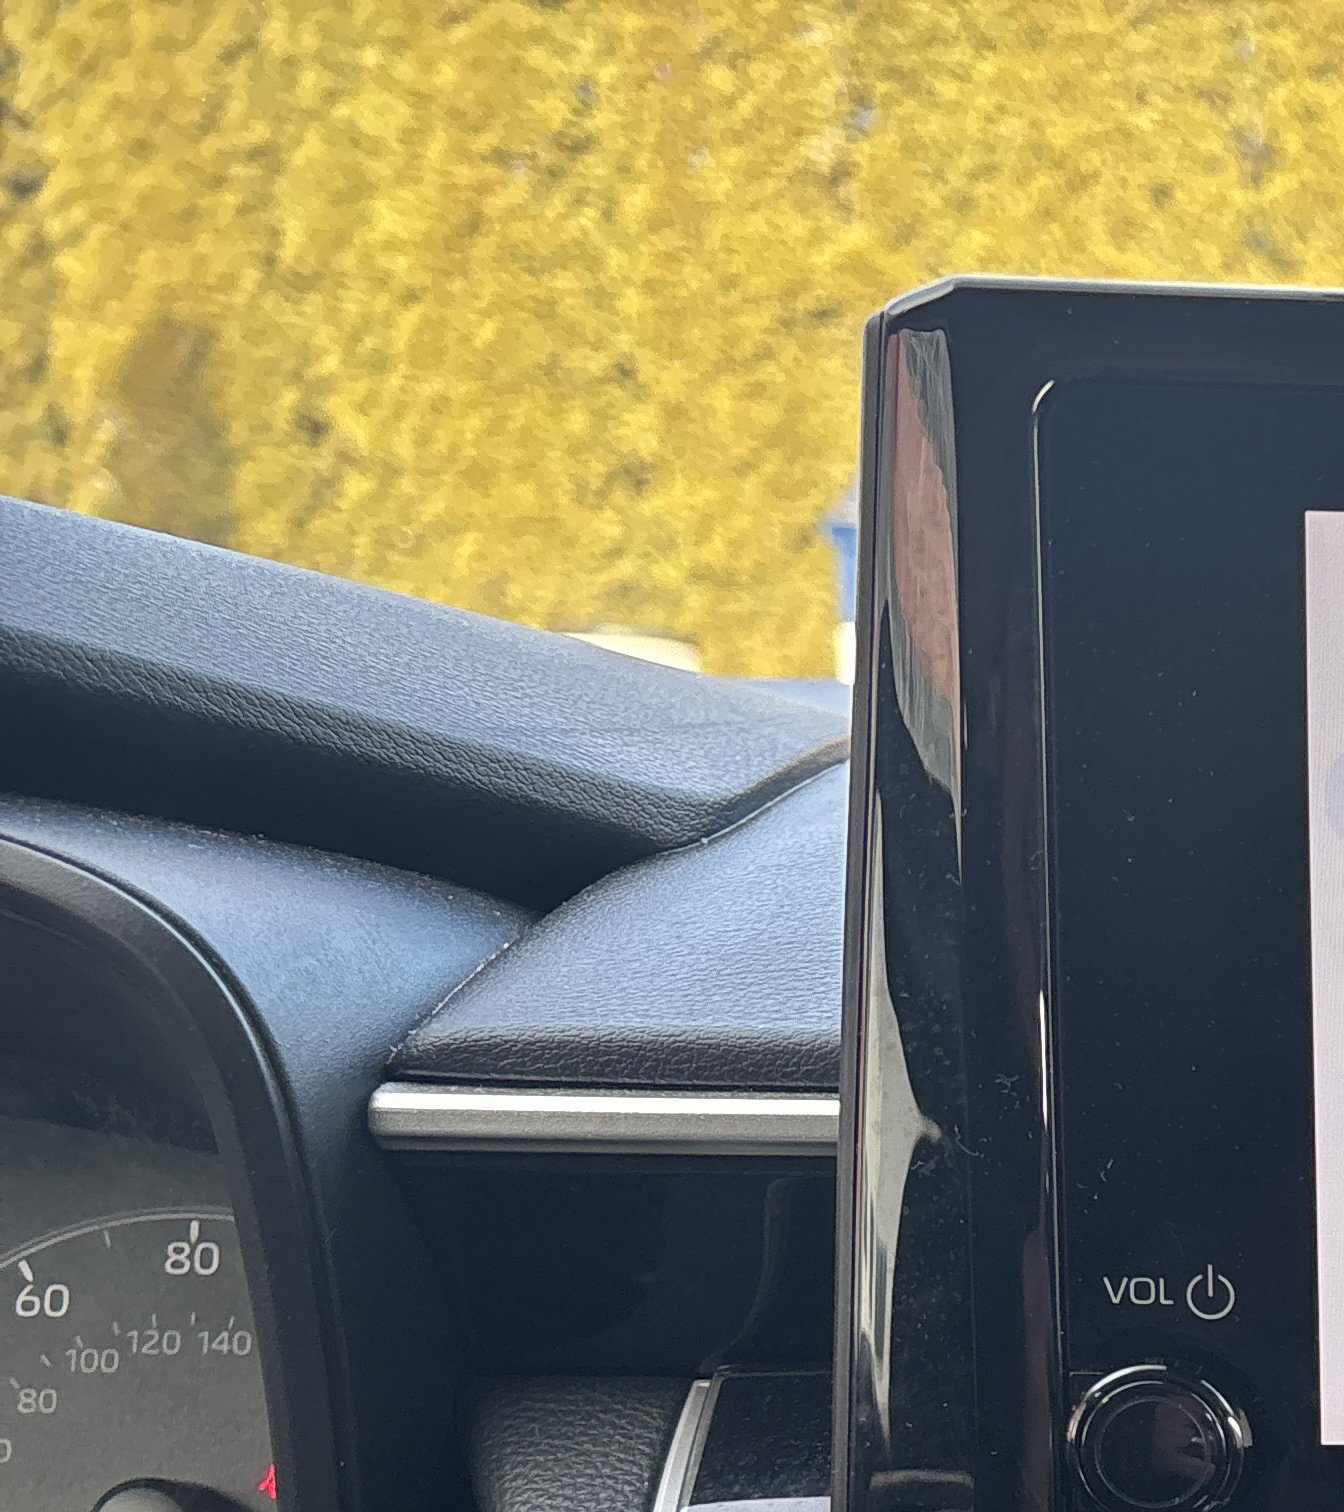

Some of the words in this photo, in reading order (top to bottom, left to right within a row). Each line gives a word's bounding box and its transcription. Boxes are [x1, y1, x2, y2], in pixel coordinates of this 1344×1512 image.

[164, 1240, 221, 1277] 80
[15, 1284, 70, 1318] 60
[1103, 1276, 1174, 1305] VOL
[65, 1348, 120, 1374] 100
[127, 1330, 182, 1356] 120
[198, 1330, 252, 1356] 140
[16, 1388, 58, 1414] 80
